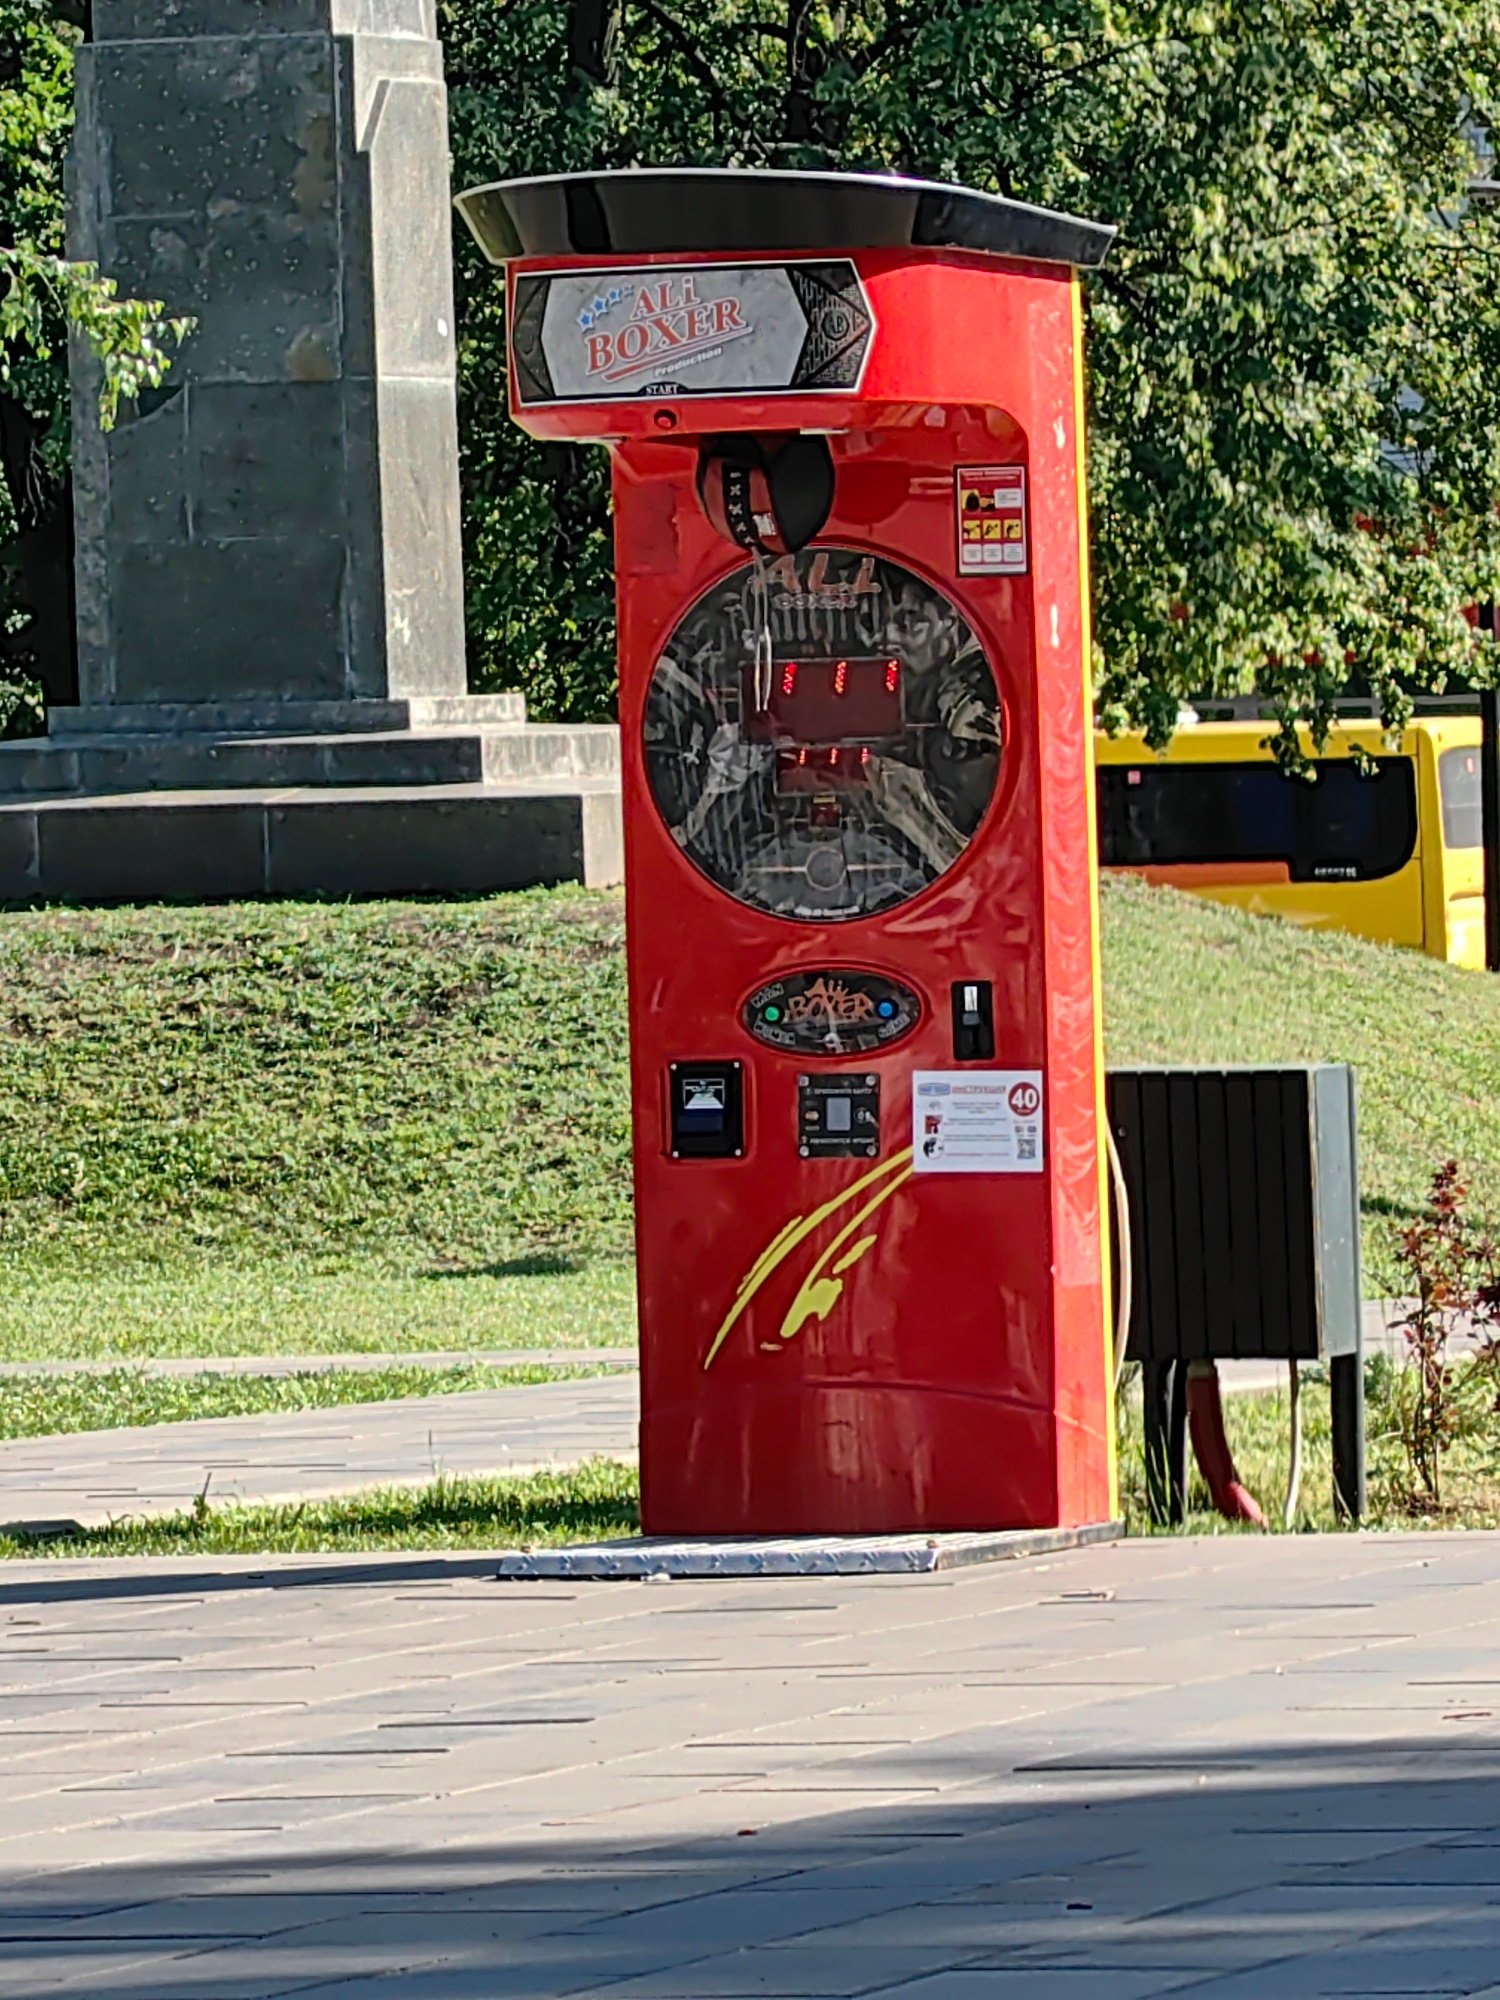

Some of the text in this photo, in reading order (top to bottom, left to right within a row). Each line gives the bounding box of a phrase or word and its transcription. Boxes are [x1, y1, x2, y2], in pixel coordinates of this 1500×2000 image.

[584, 296, 746, 376] BOXER
[654, 346, 722, 377] Production
[646, 384, 679, 395] START
[788, 992, 874, 1022] BOXER
[1011, 1088, 1037, 1108] 40
